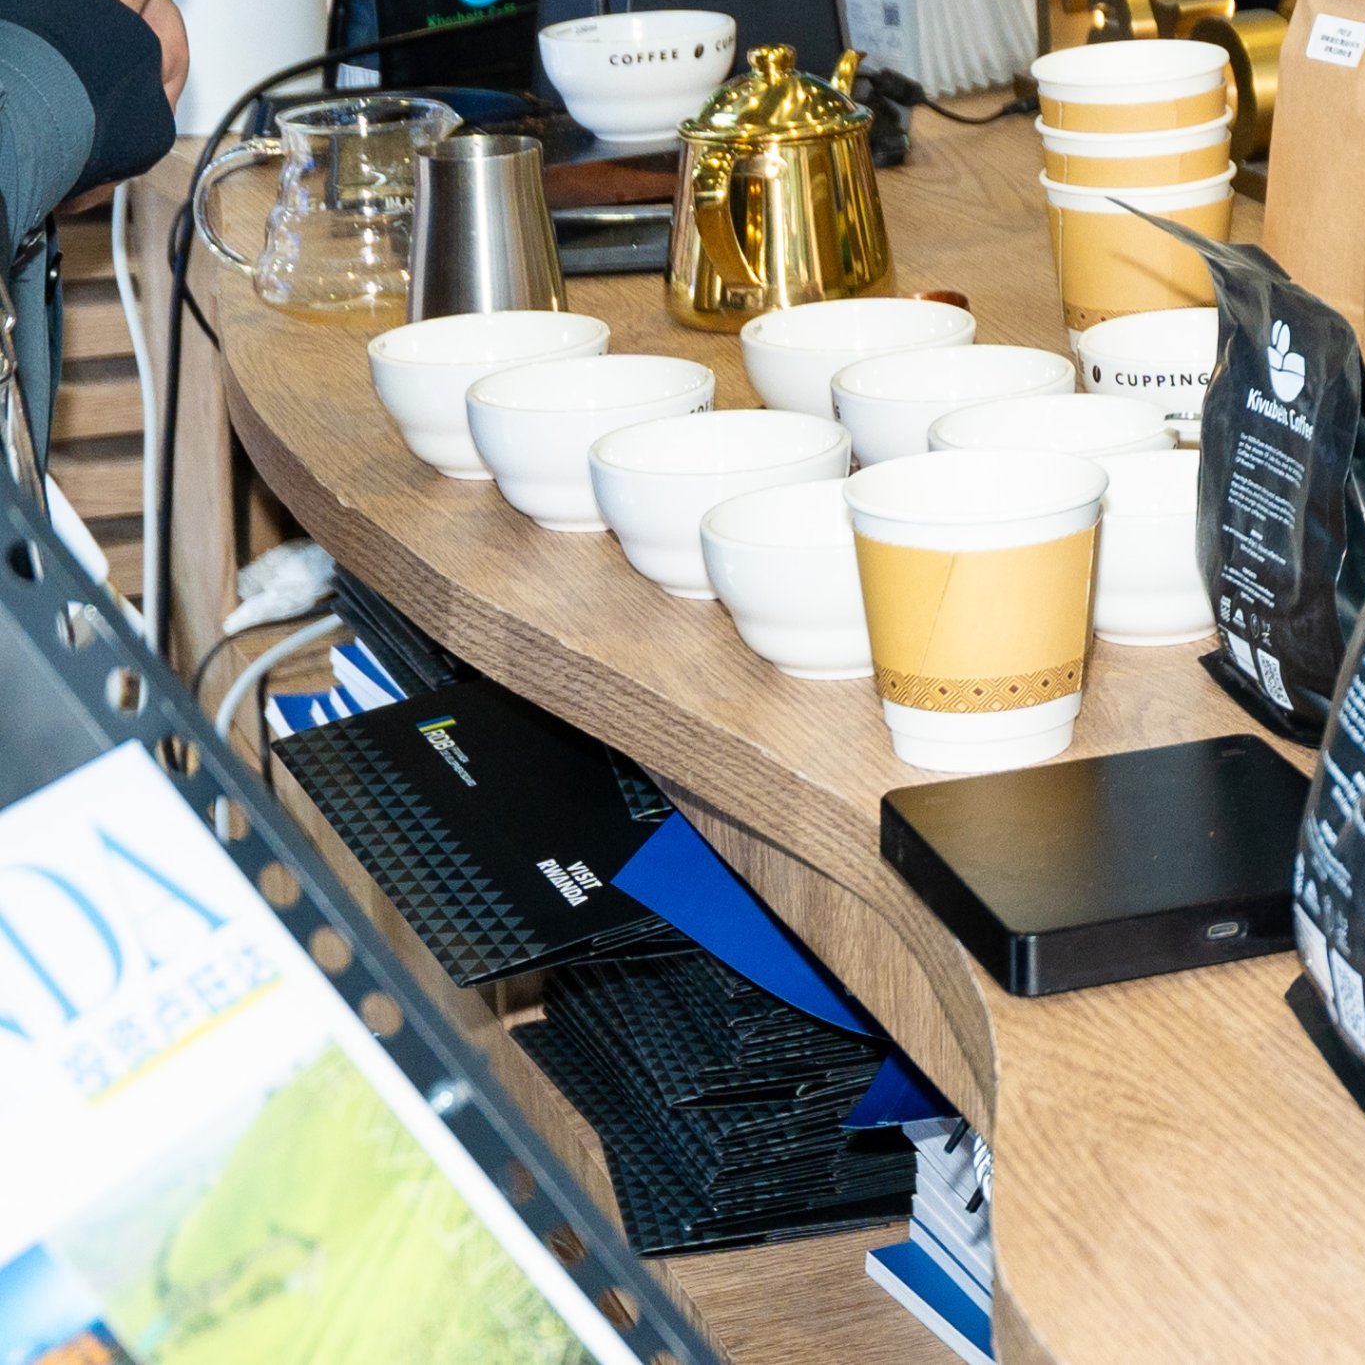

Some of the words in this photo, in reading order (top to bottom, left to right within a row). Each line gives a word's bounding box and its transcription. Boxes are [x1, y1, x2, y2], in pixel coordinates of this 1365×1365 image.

[609, 47, 679, 67] COFFEE
[1114, 372, 1211, 388] CUPPING
[536, 858, 590, 907] RWANDA
[566, 860, 604, 890] VISIT
